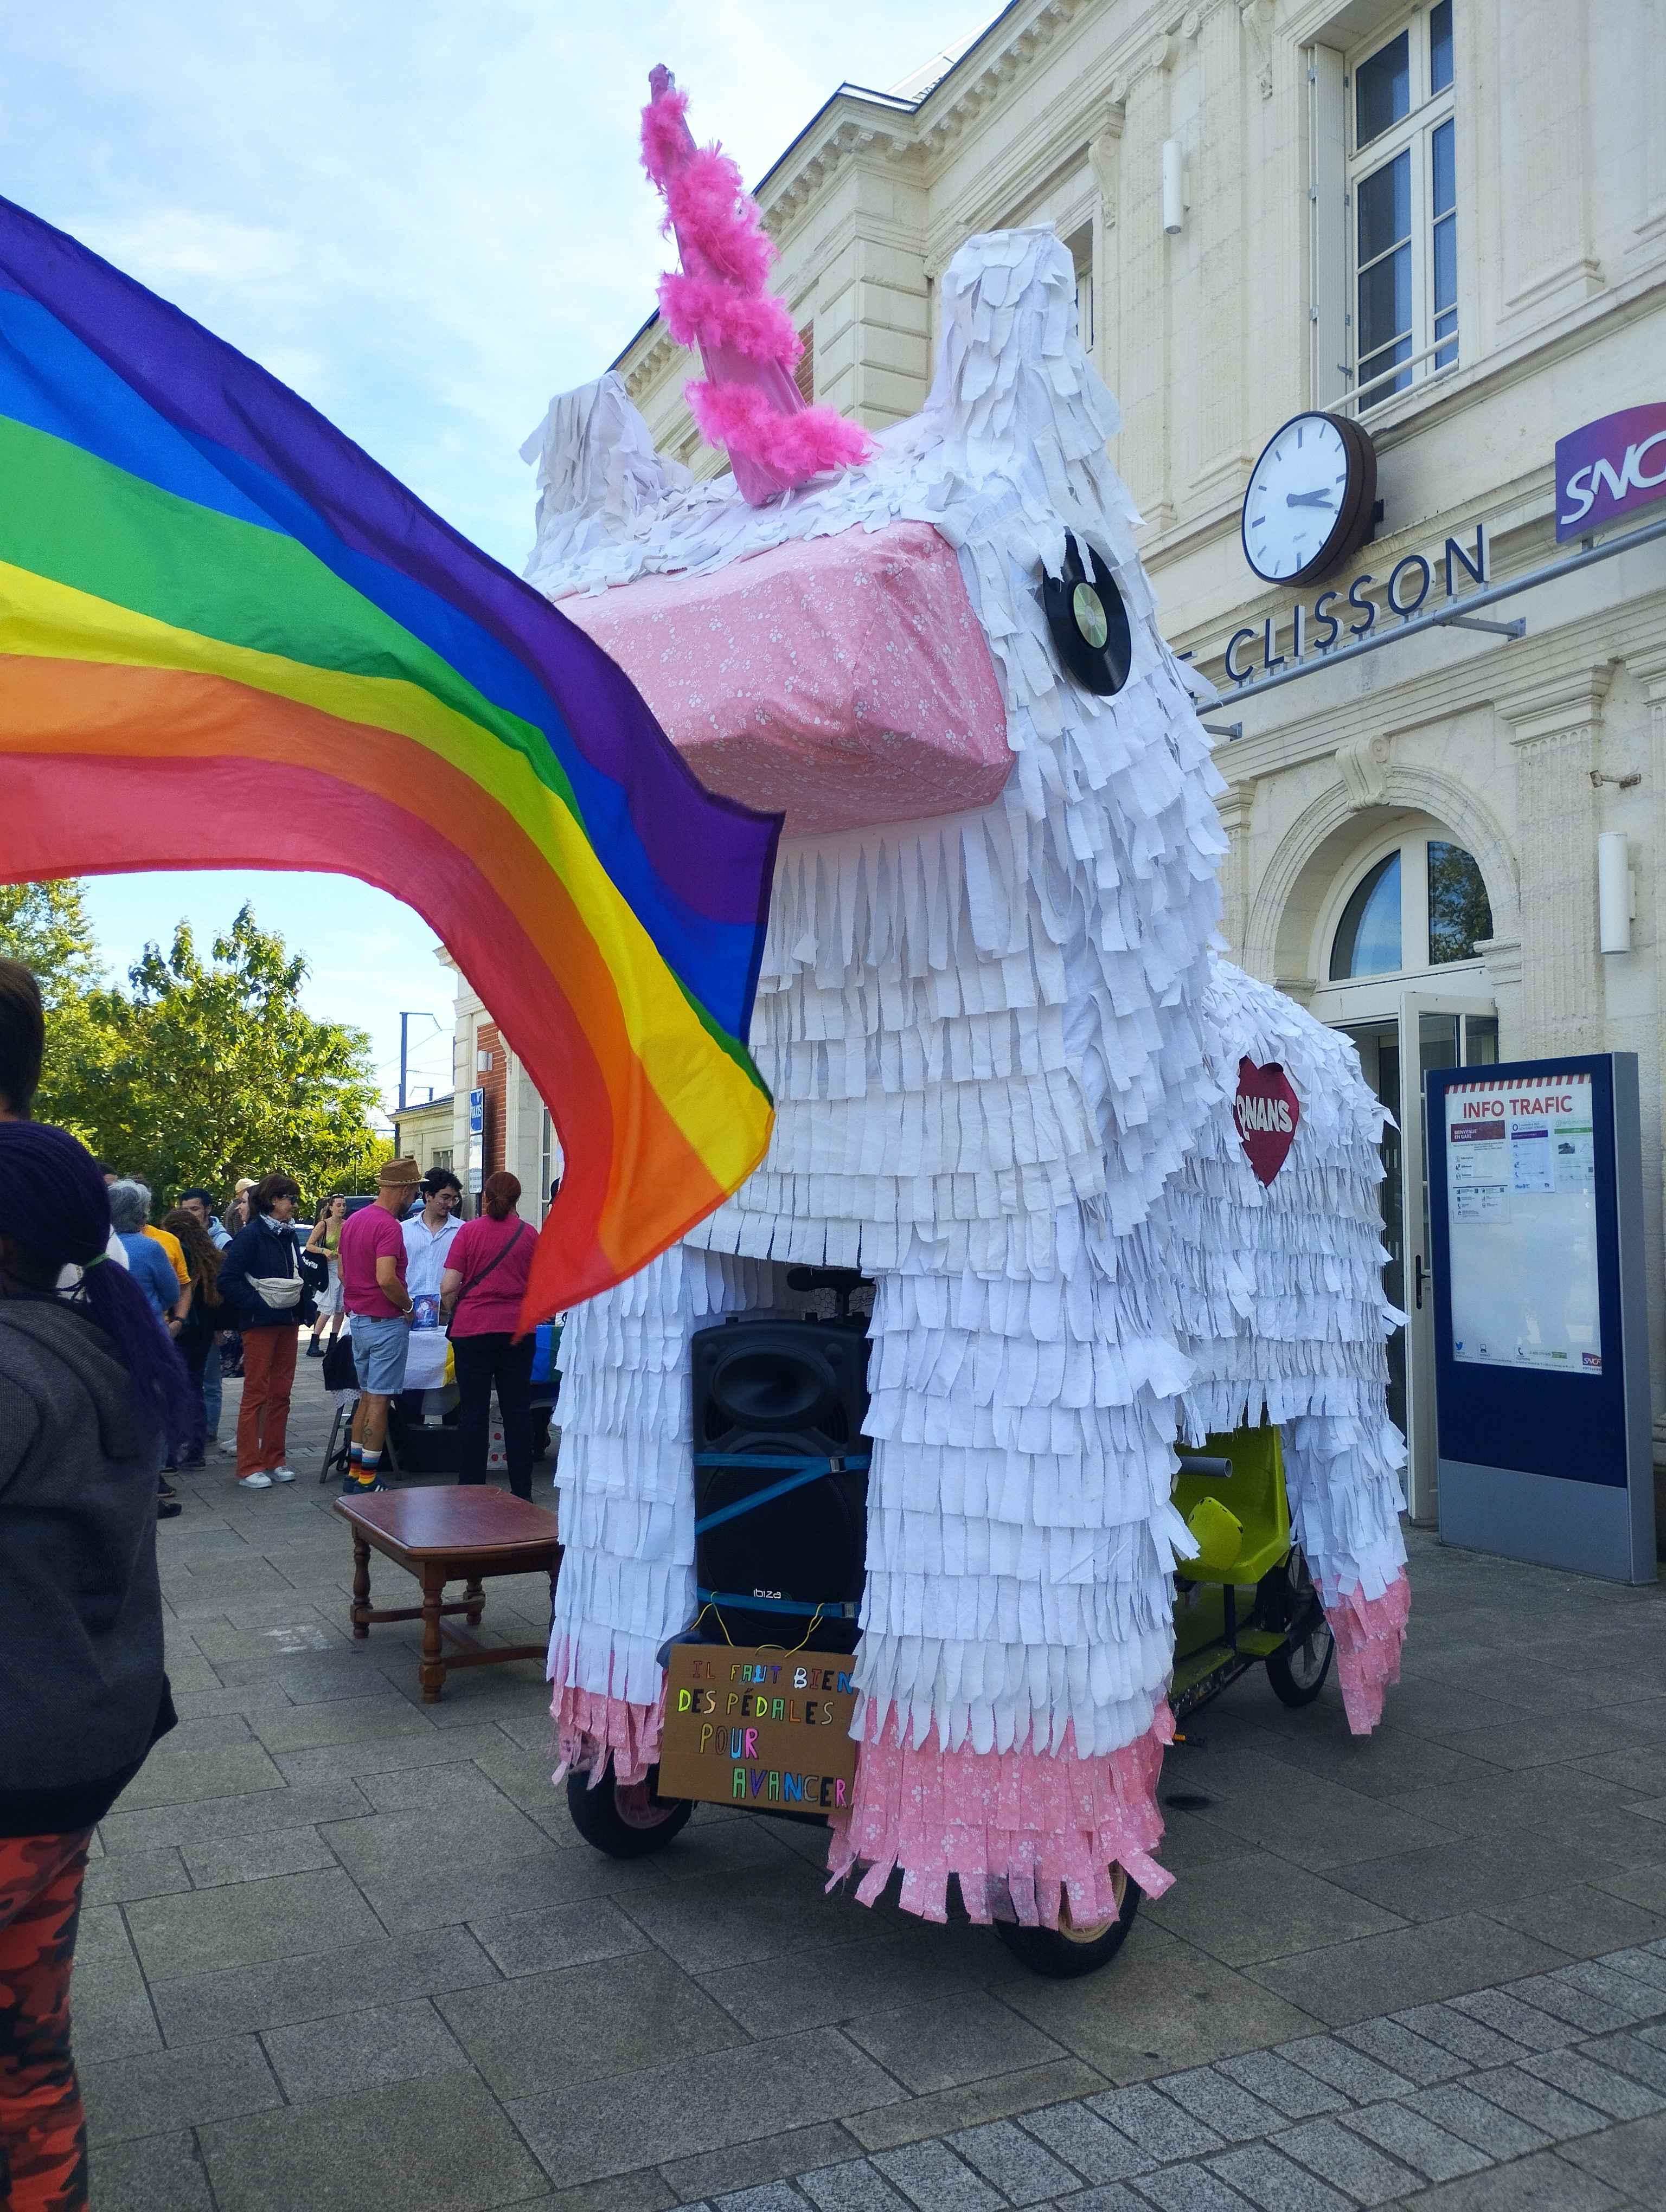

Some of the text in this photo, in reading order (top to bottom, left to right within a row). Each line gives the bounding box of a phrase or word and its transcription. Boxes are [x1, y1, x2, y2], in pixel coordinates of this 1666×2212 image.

[1225, 524, 1490, 681] CLISSON
[1463, 1095, 1573, 1118] INFO TRAFIC
[1583, 1357, 1601, 1365] SNCF
[693, 1660, 854, 1695] IL FAUT BIEN
[677, 1687, 834, 1725] DES PÉDALES
[699, 1722, 759, 1760] POUR
[732, 1766, 848, 1809] AVANCER
